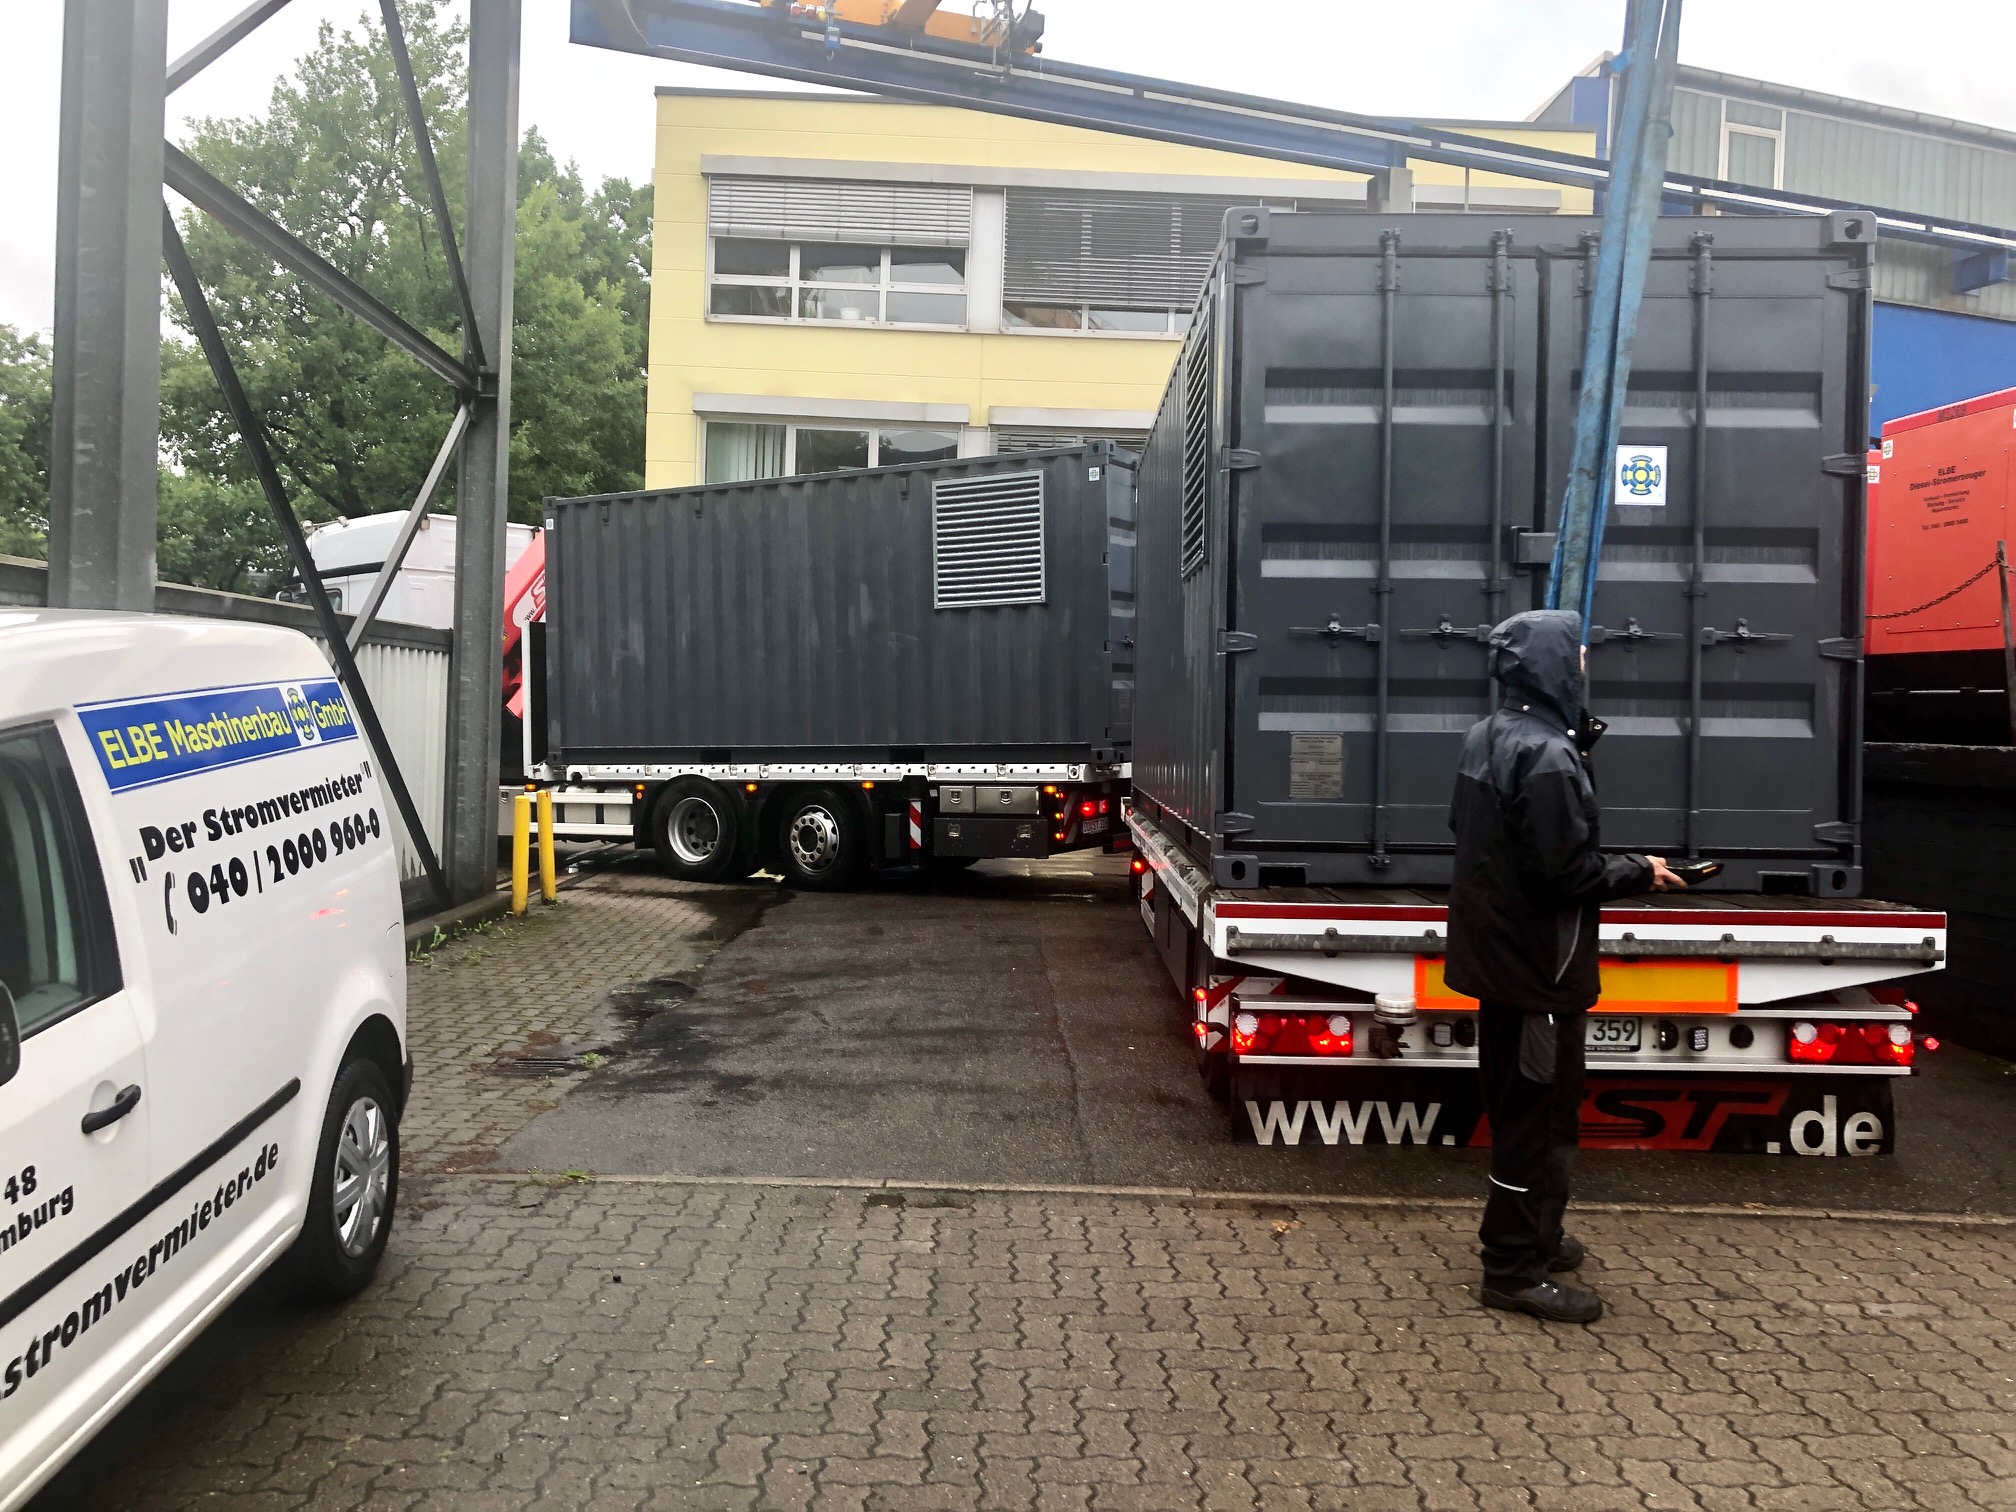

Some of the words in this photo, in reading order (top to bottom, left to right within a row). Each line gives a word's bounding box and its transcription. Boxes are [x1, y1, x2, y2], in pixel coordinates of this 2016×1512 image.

[97, 722, 168, 770] ELBE
[163, 705, 293, 756] Maschinenbau
[311, 697, 351, 729] GmbH
[187, 857, 249, 914] 040
[266, 827, 327, 884] 2000
[329, 807, 381, 857] 960-0
[1592, 1019, 1636, 1042] 359
[4, 1165, 38, 1205] 48
